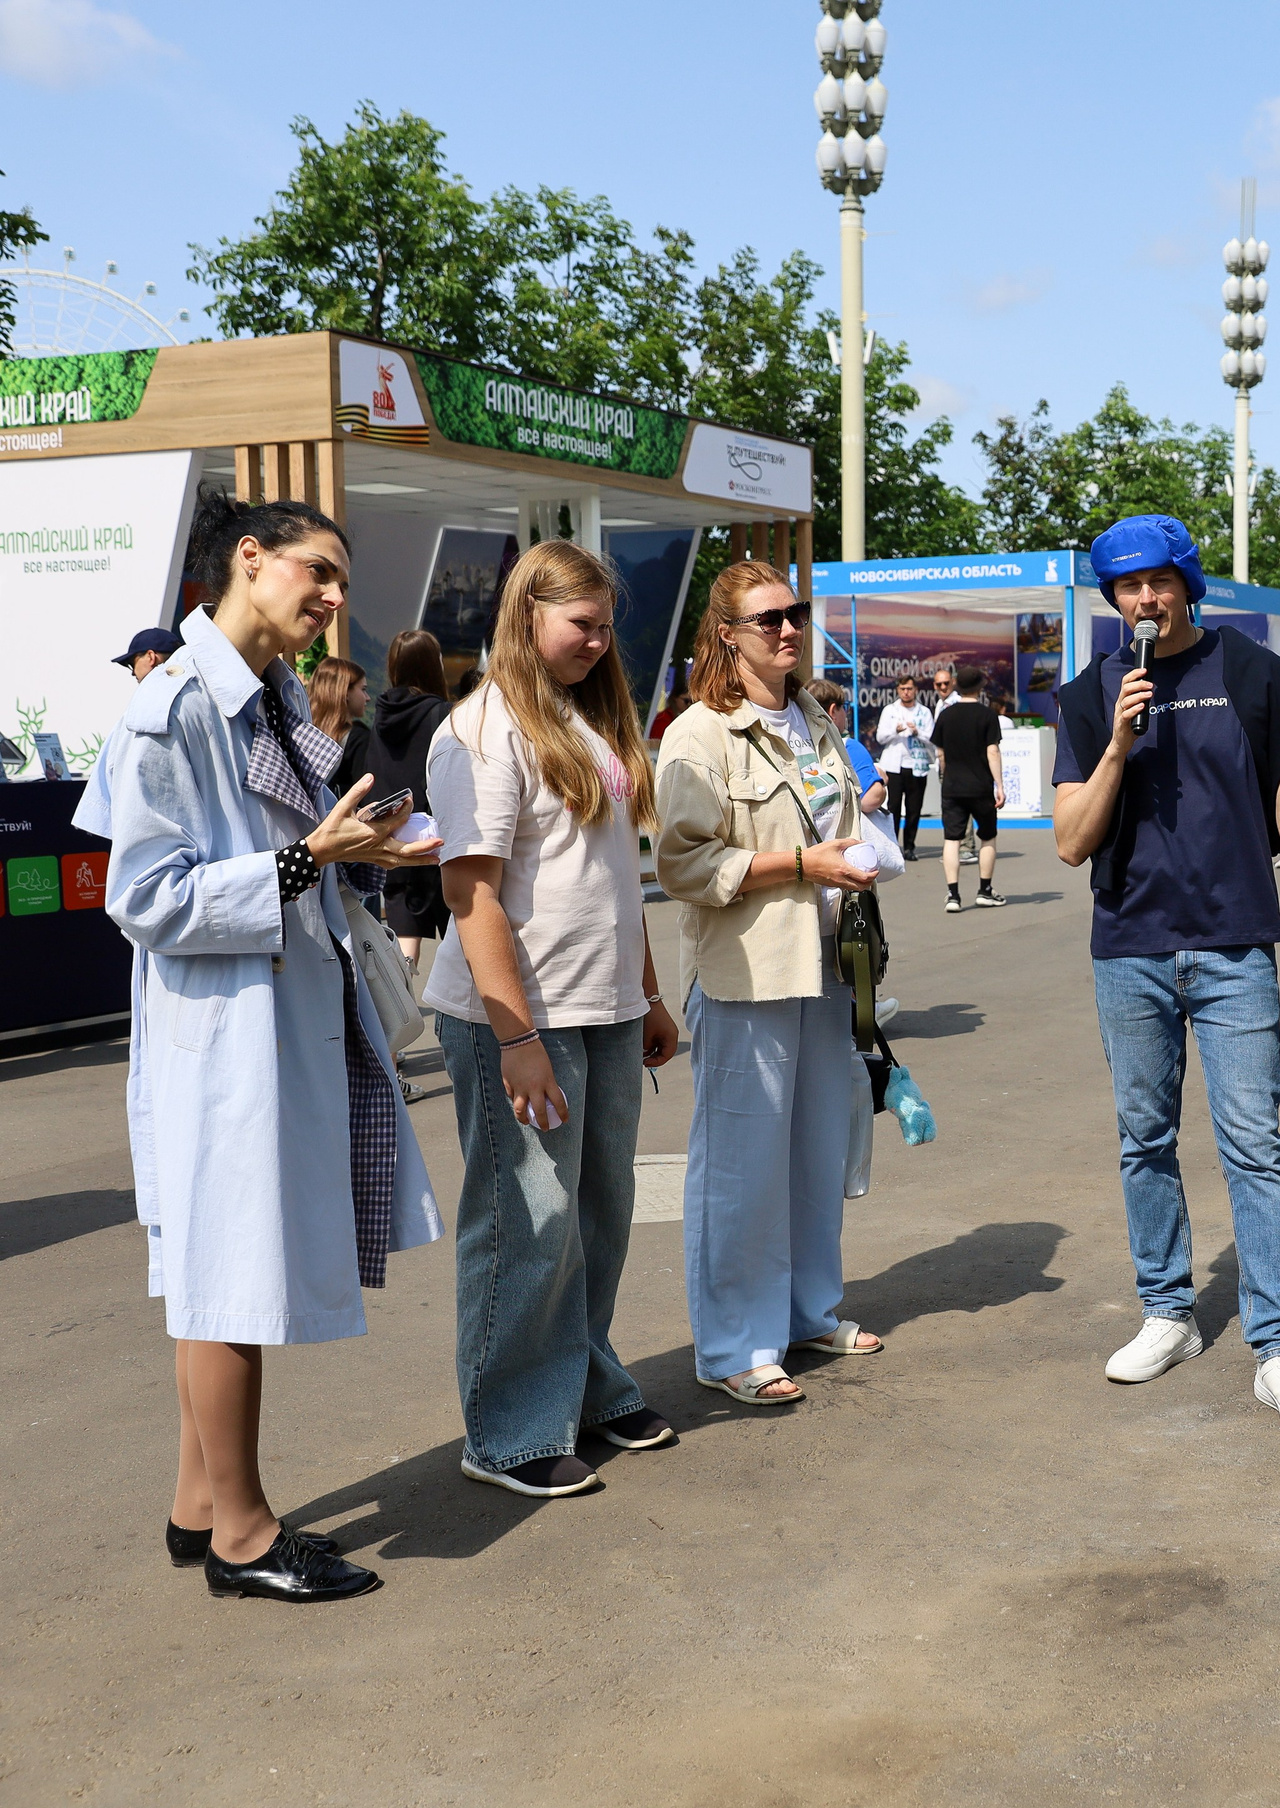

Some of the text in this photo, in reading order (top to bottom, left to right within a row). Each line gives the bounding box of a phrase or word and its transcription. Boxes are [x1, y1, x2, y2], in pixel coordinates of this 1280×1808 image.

[40, 385, 92, 424] КРАЙ
[485, 379, 634, 440] АЛТАЙСКИЙ КРАЙ
[517, 426, 612, 460] все настоящее!
[0, 523, 133, 554] АЛТАЙСКИЙ КРАЙ
[23, 555, 111, 573] все настоящее!
[850, 563, 1022, 584] НОВОСИБИРСКАЯ ОБЛАСТЬ
[870, 655, 919, 678] ОТКРОЙ
[1149, 697, 1228, 715] ОЯРСКИЙ КРАЙ
